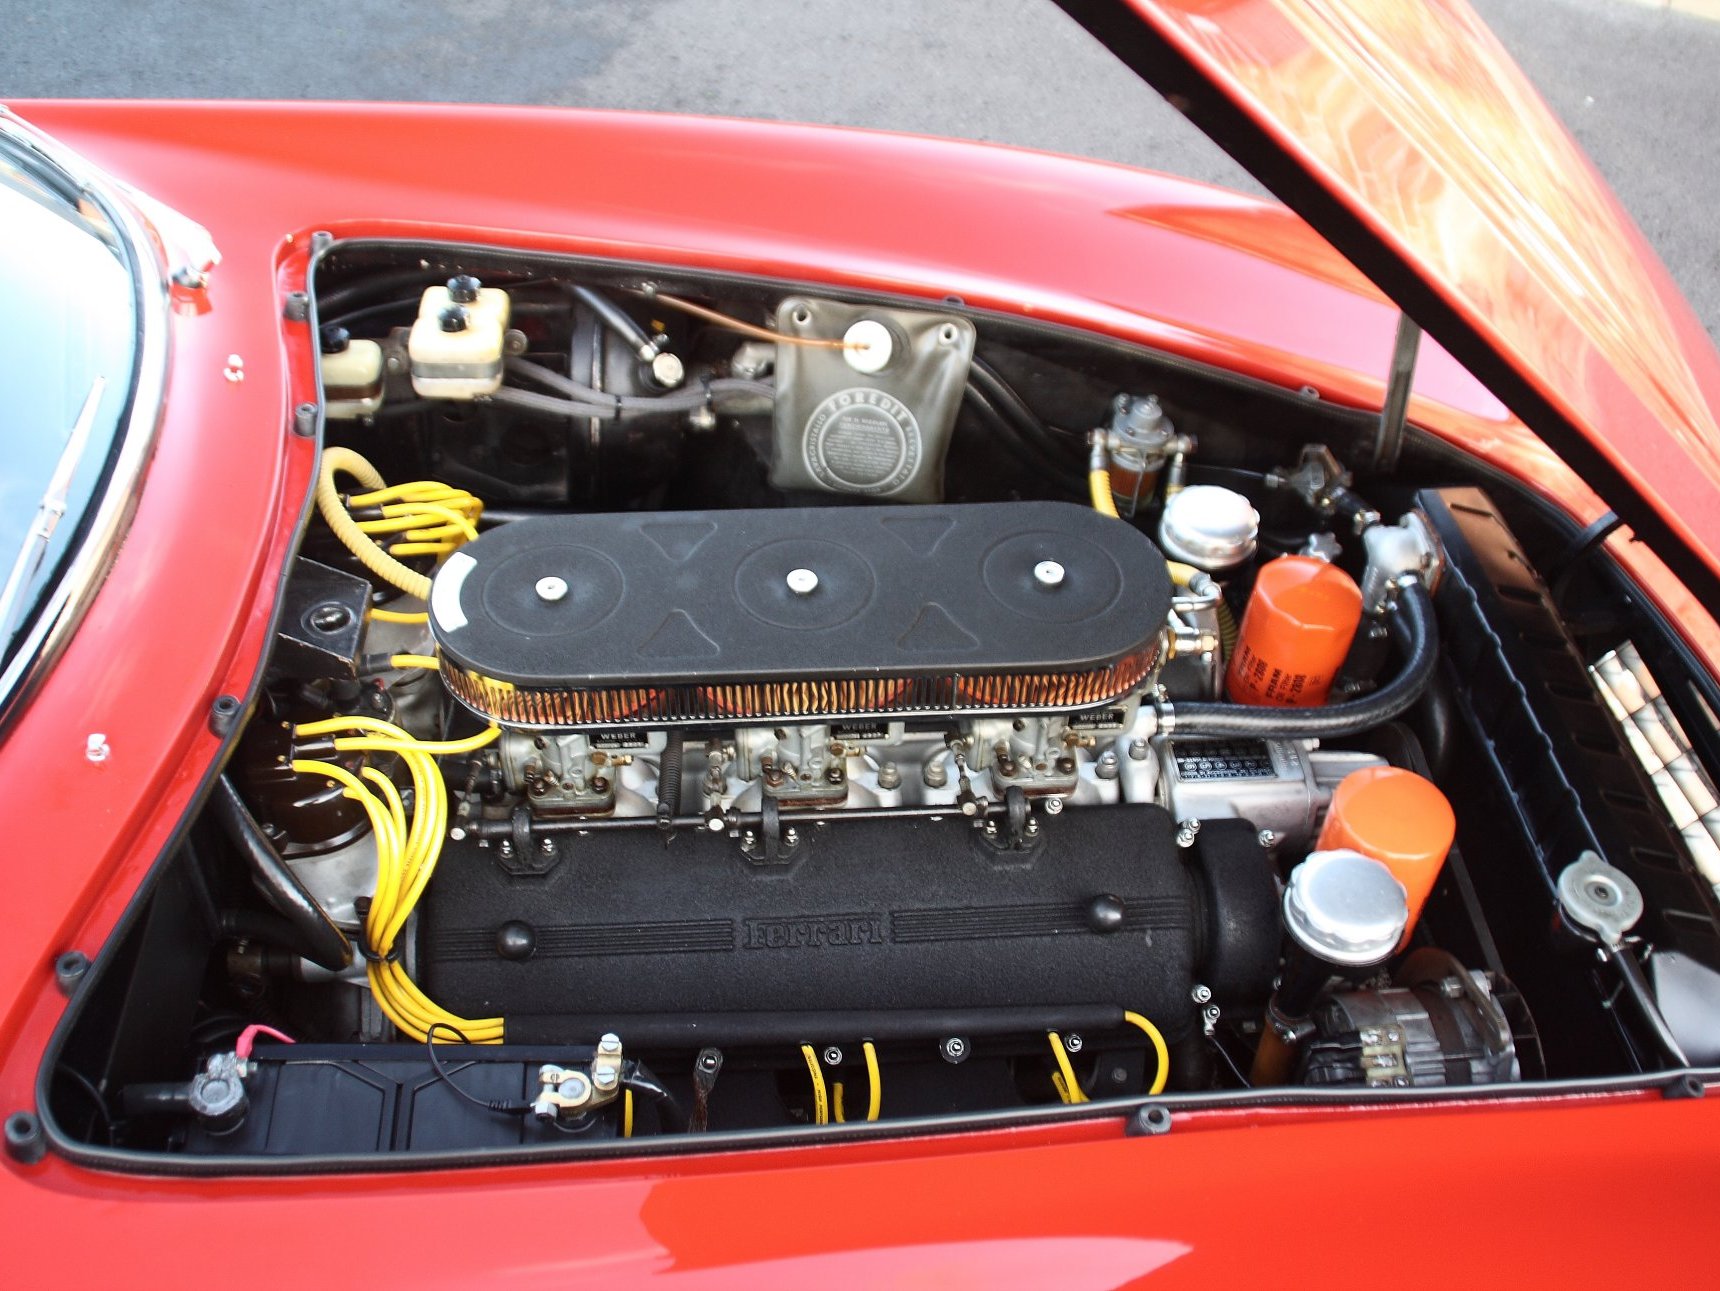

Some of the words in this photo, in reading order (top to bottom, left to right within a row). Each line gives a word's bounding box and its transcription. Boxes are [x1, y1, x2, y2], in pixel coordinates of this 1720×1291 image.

[1266, 668, 1282, 698] FRAM
[1079, 713, 1115, 721] WEBER
[842, 723, 878, 731] WEBER
[600, 732, 637, 740] WEBER
[743, 912, 883, 950] Ferrari
